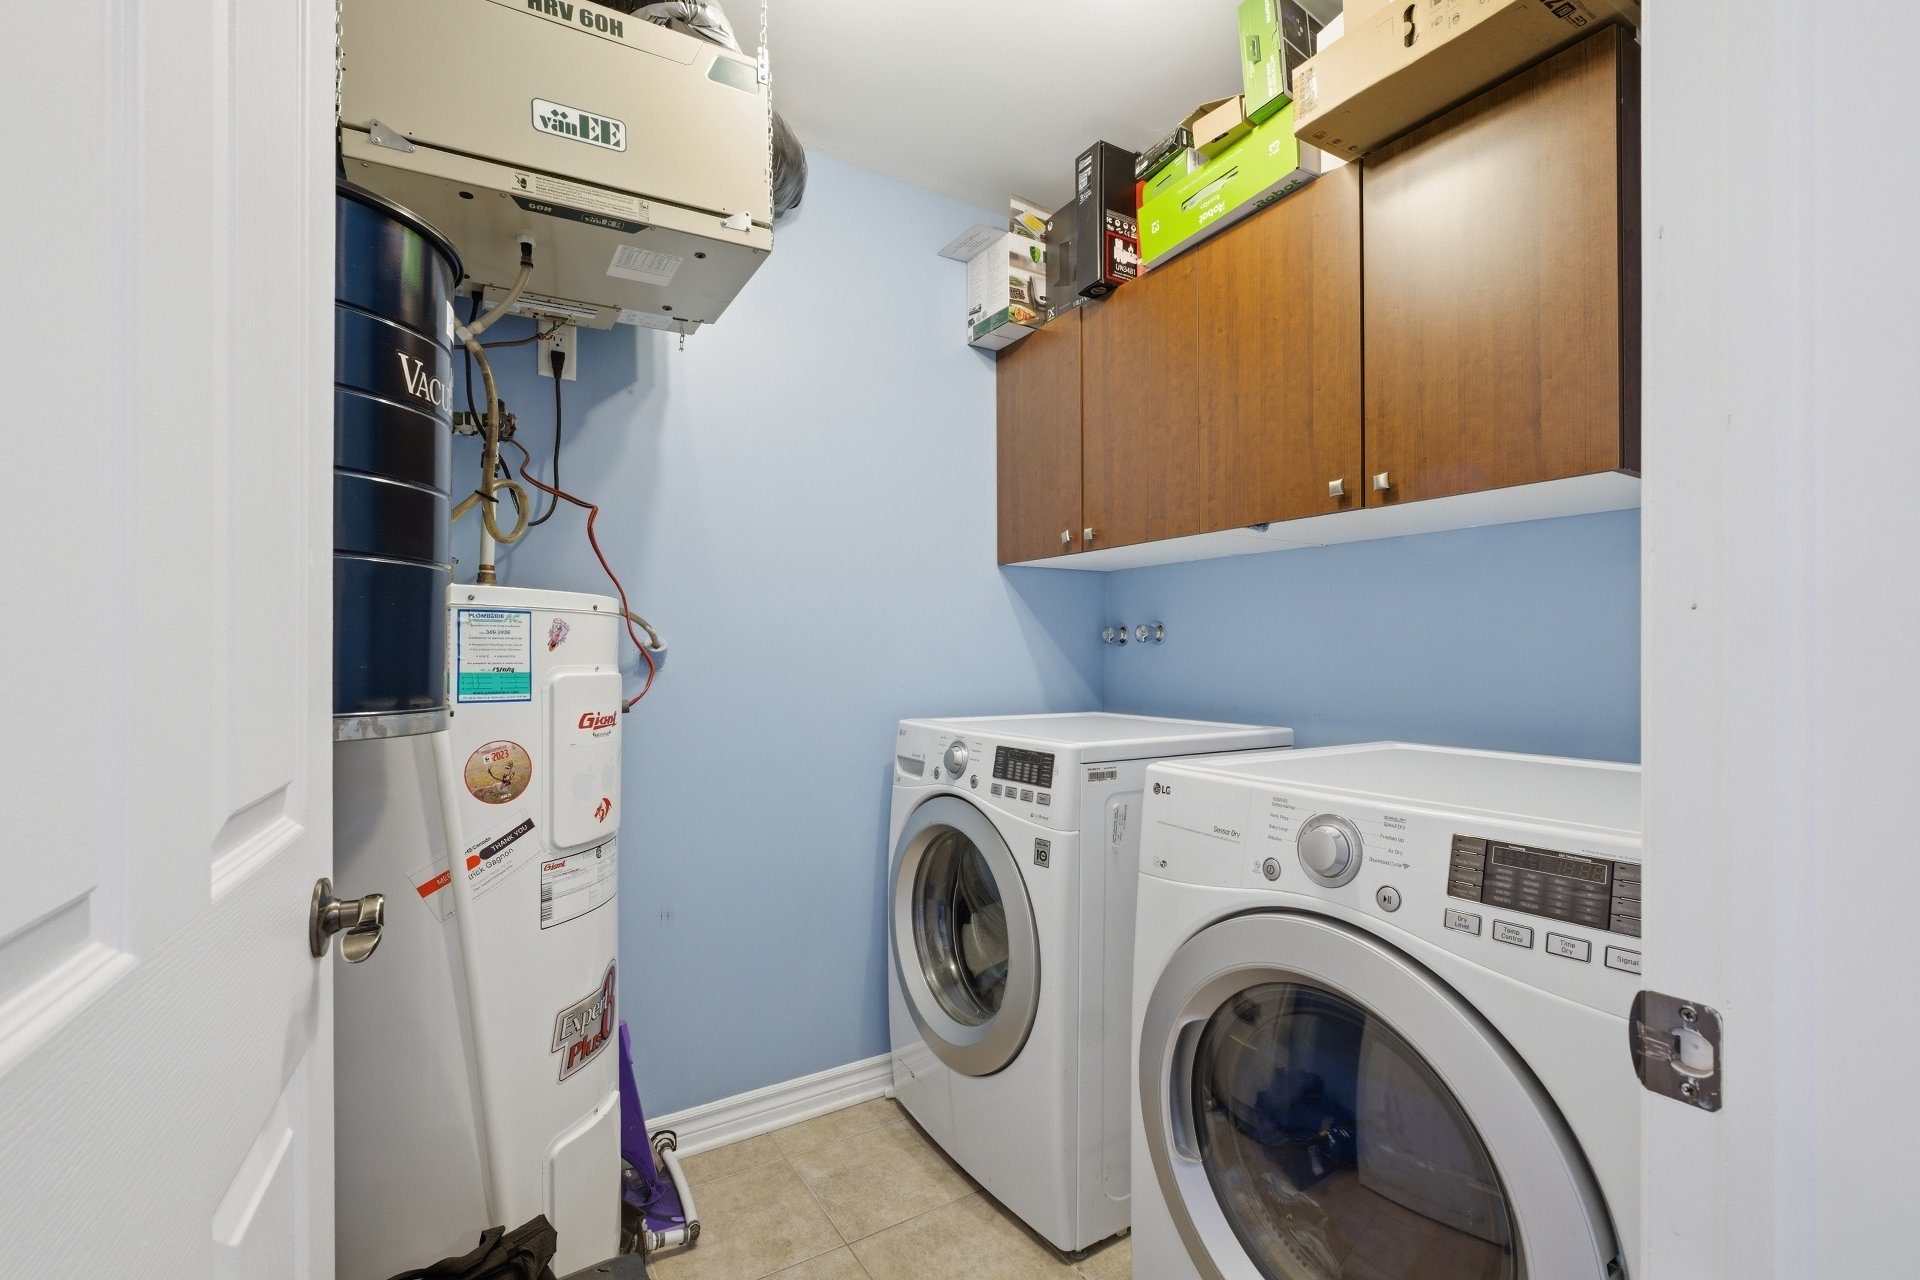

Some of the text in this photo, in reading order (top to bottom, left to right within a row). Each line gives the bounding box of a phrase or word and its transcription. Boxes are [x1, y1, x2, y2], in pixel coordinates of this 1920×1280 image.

[527, 0, 624, 39] HRV 60H
[578, 710, 618, 731] Giant
[491, 749, 510, 762] 2023
[490, 823, 529, 852] THANK YOU
[1213, 825, 1241, 839] Sensor Dry
[485, 848, 515, 871] Gagnon
[1454, 921, 1470, 931] Level
[1457, 915, 1468, 924] Dry
[1501, 932, 1524, 943] Control
[1503, 926, 1521, 936] Temp
[1560, 939, 1576, 949] Time
[1561, 946, 1574, 956] Dry
[560, 992, 609, 1042] Expert
[567, 1033, 603, 1070] Plus
